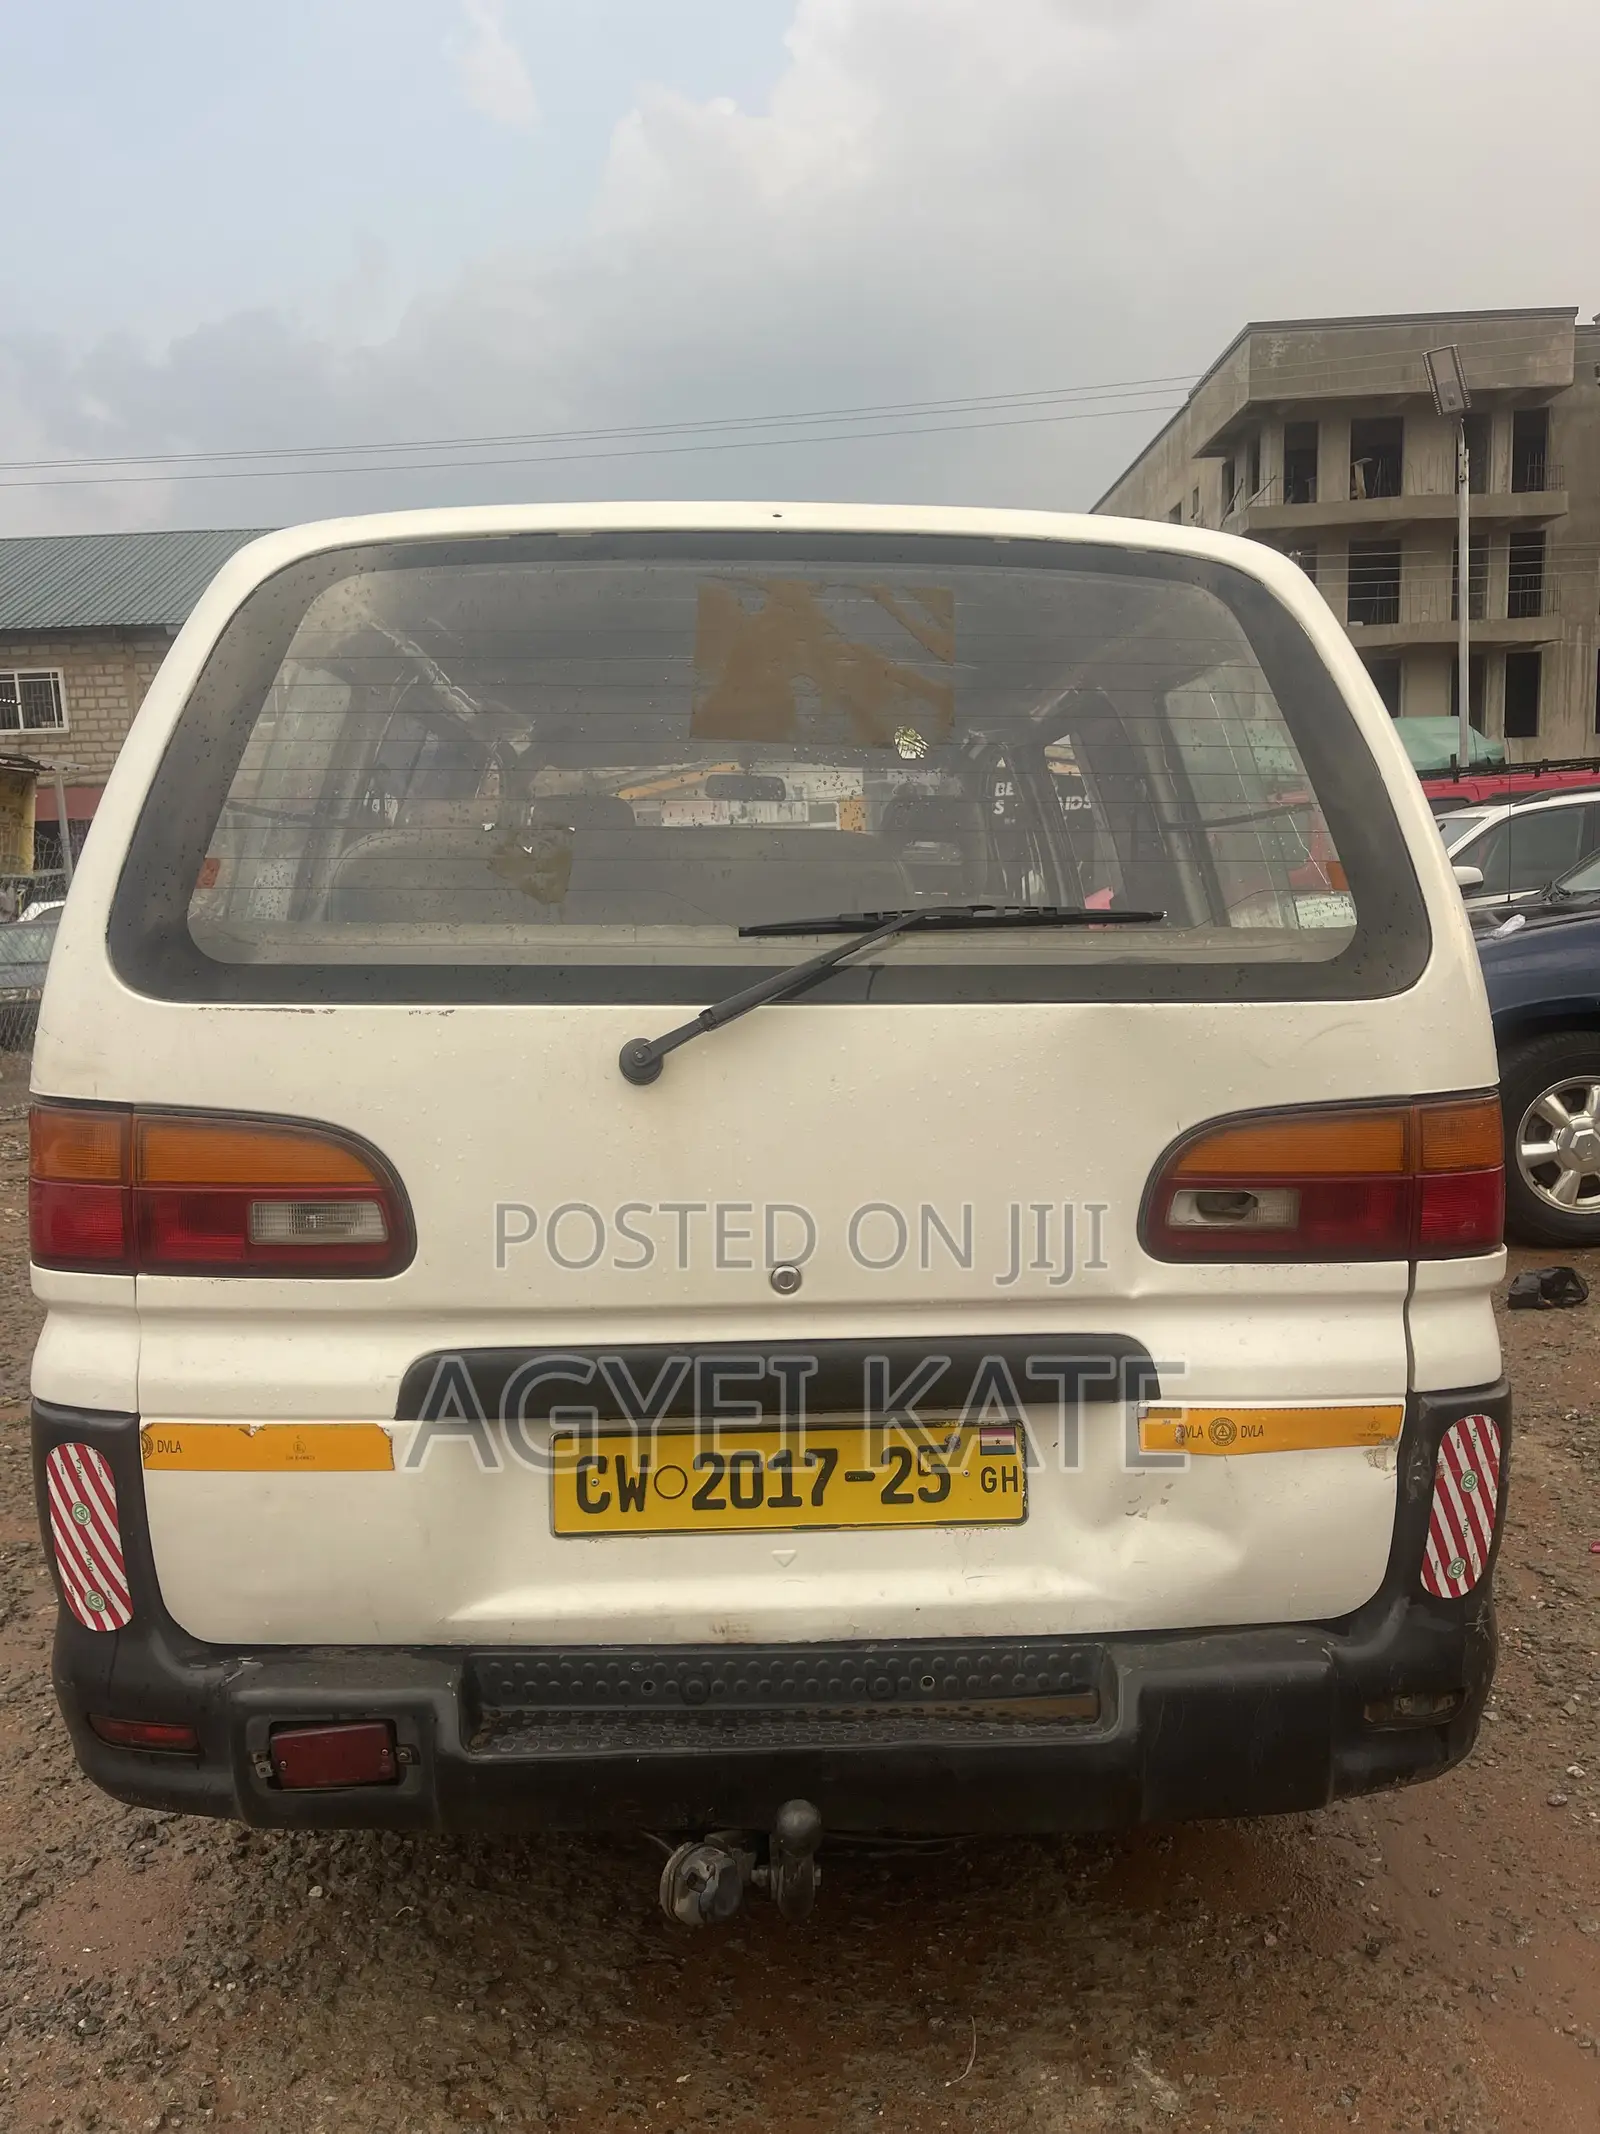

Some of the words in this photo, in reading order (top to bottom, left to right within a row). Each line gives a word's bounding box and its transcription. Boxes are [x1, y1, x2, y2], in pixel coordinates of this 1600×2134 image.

[1241, 1424, 1264, 1438] DVLA
[157, 1439, 182, 1453] DVLA
[576, 1454, 650, 1514] CW
[980, 1465, 1019, 1493] GH
